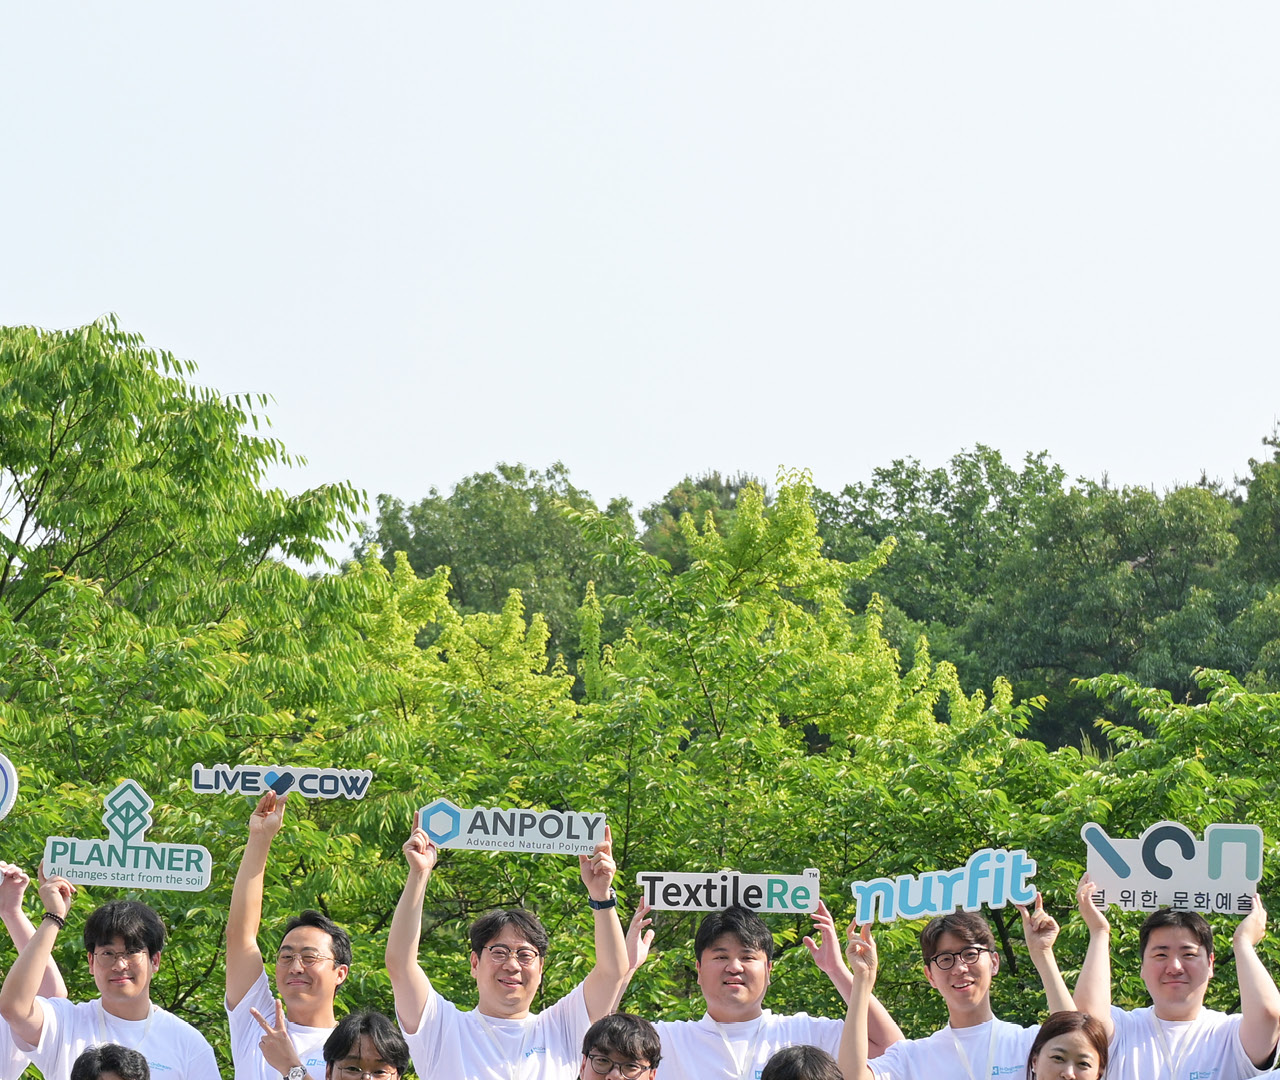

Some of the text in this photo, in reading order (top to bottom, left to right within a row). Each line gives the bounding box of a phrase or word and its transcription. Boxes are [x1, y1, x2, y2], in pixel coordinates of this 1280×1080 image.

[194, 769, 369, 796] LIVE COW
[467, 811, 601, 840] ANPOLY
[50, 841, 204, 872] PLANTNER
[467, 838, 515, 849] Advanced
[519, 840, 555, 851] Natural
[50, 868, 203, 886] All changes start from the soil
[856, 854, 1034, 922] nurfit
[642, 875, 810, 910] TextileRe
[1120, 889, 1158, 904] 위한
[1173, 892, 1253, 910] 문화예술
